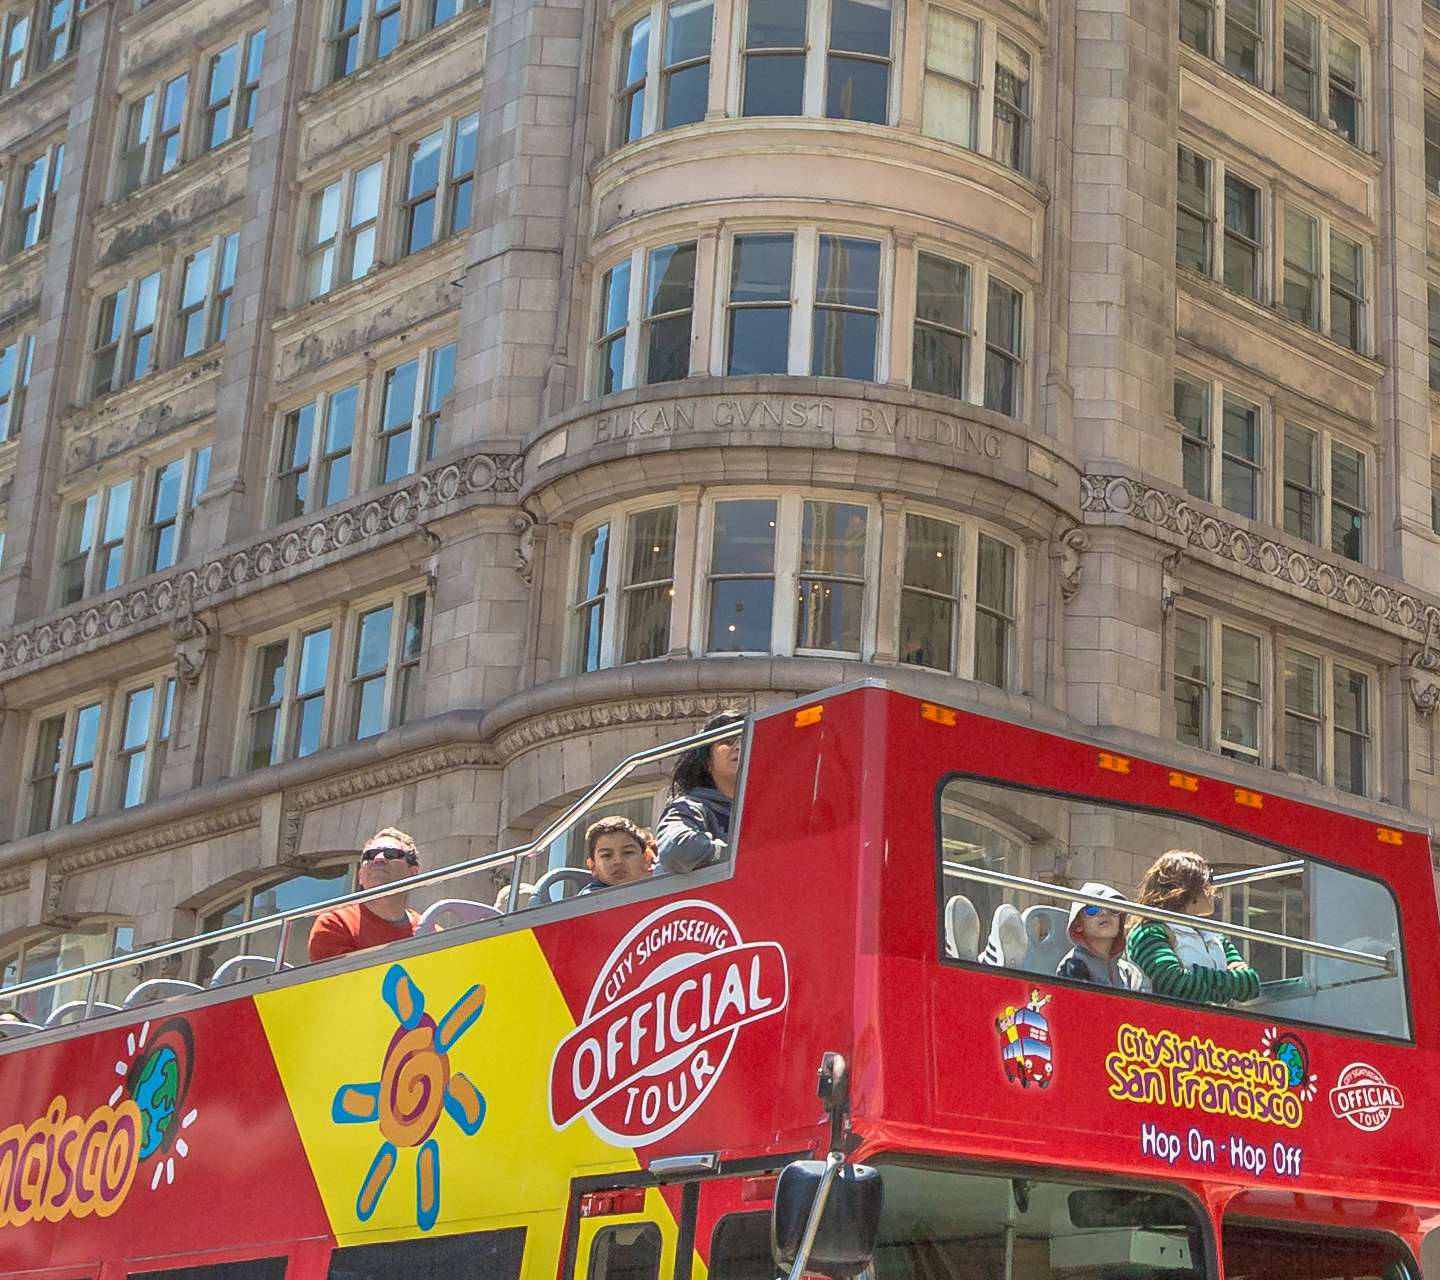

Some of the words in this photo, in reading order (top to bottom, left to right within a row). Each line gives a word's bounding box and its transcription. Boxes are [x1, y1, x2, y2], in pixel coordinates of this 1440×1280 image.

[604, 957, 634, 1002] CITY
[636, 919, 728, 964] SIGHTSEEING
[572, 953, 772, 1101] OFFICIAL
[624, 1049, 716, 1125] TOUR
[1106, 1051, 1171, 1105] San
[1168, 1066, 1304, 1129] Francisco
[1337, 1086, 1398, 1110] OFFICIAL
[1358, 1110, 1387, 1126] TOUR
[1141, 1123, 1181, 1162] Hop
[1188, 1127, 1216, 1163] On
[1229, 1136, 1267, 1175] Hop
[1273, 1141, 1304, 1176] Off
